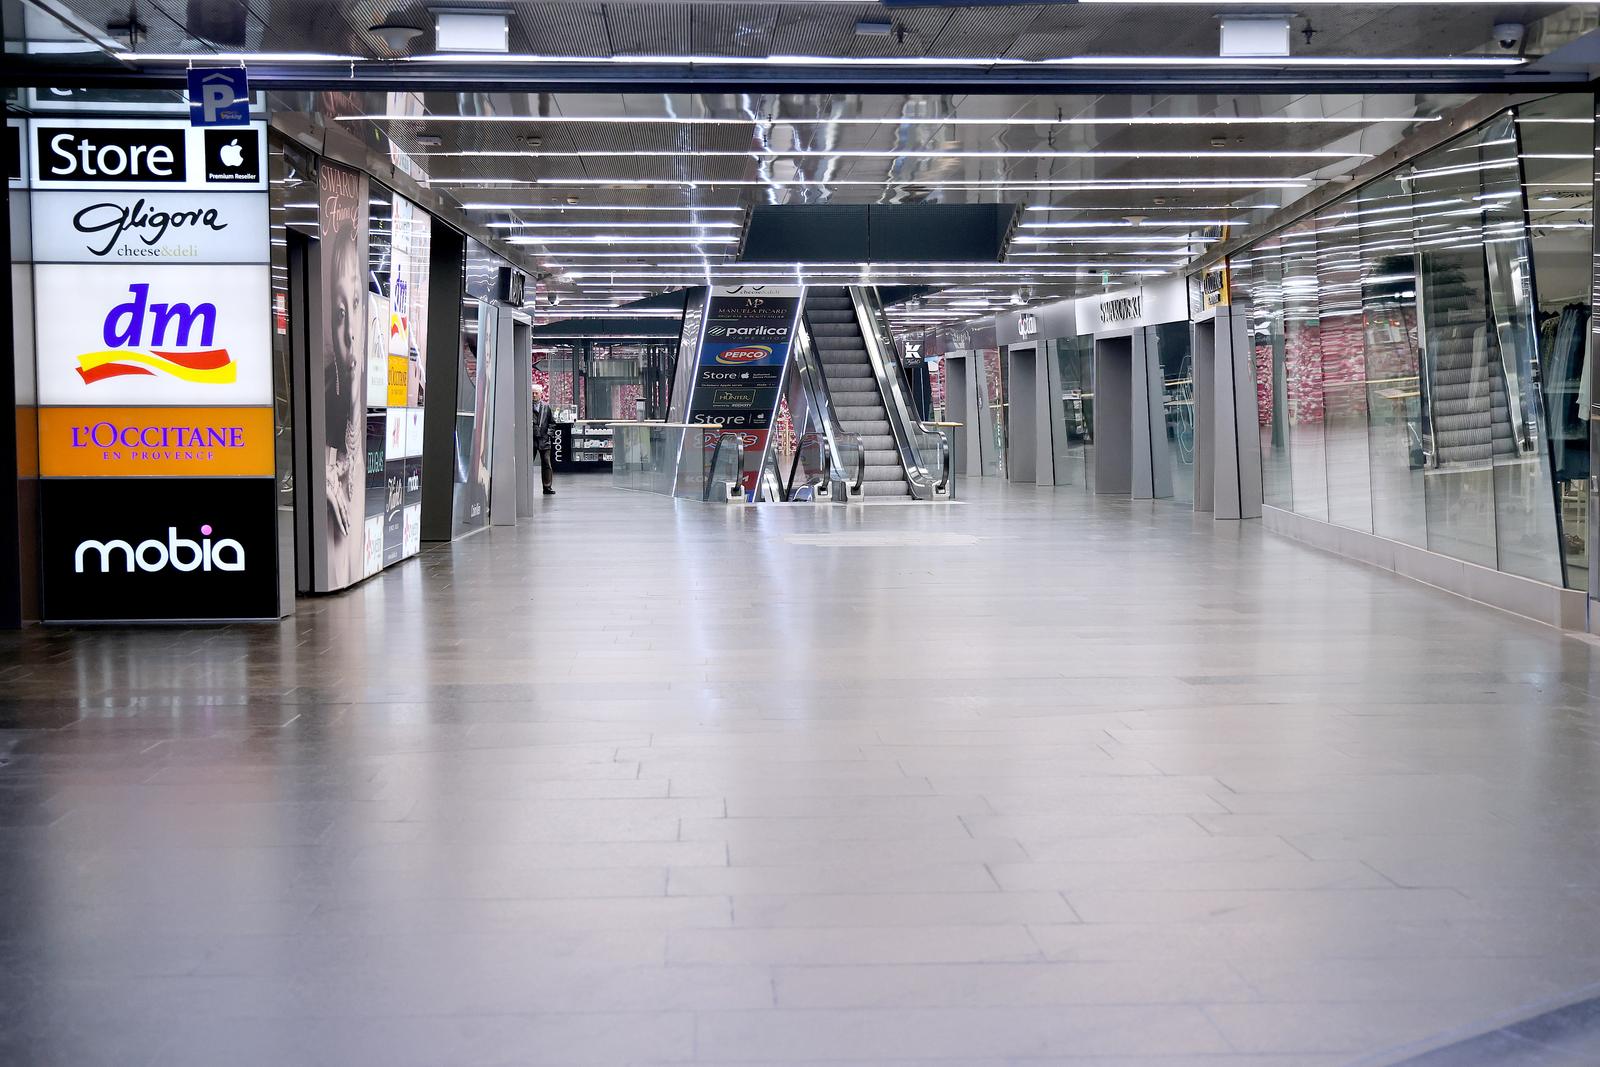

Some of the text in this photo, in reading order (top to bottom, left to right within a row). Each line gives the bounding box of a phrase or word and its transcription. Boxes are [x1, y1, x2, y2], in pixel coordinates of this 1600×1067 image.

[202, 84, 235, 122] P
[51, 133, 174, 176] Store
[117, 245, 198, 257] cheese&deli
[103, 283, 217, 348] dm
[726, 325, 788, 337] parilica
[724, 351, 764, 359] PEPCO
[702, 371, 737, 380] Store
[694, 413, 745, 425] Store
[71, 422, 246, 448] L'OCCITANE
[103, 450, 215, 460] EN PROVENCE
[552, 429, 563, 462] mobia
[74, 524, 246, 573] mobia
